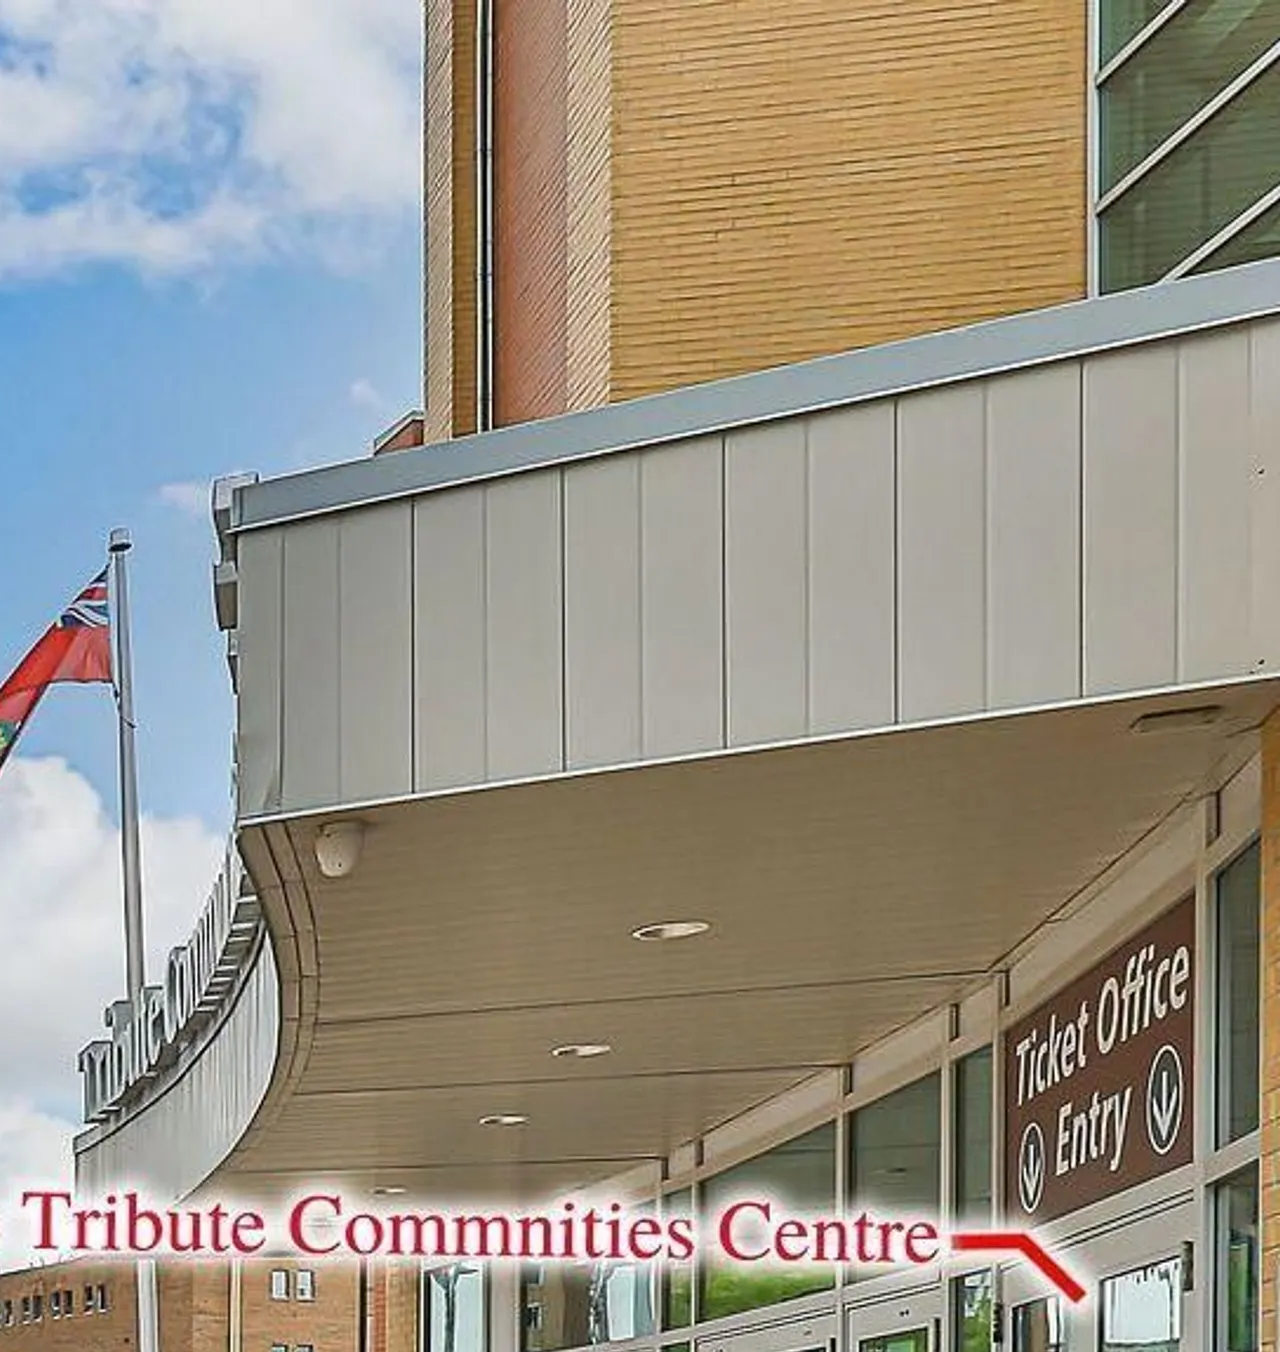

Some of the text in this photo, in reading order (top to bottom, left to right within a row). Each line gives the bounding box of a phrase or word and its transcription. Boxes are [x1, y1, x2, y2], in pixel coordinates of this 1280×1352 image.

[1015, 944, 1191, 1106] Ticket Office
[1055, 1085, 1133, 1173] Entry
